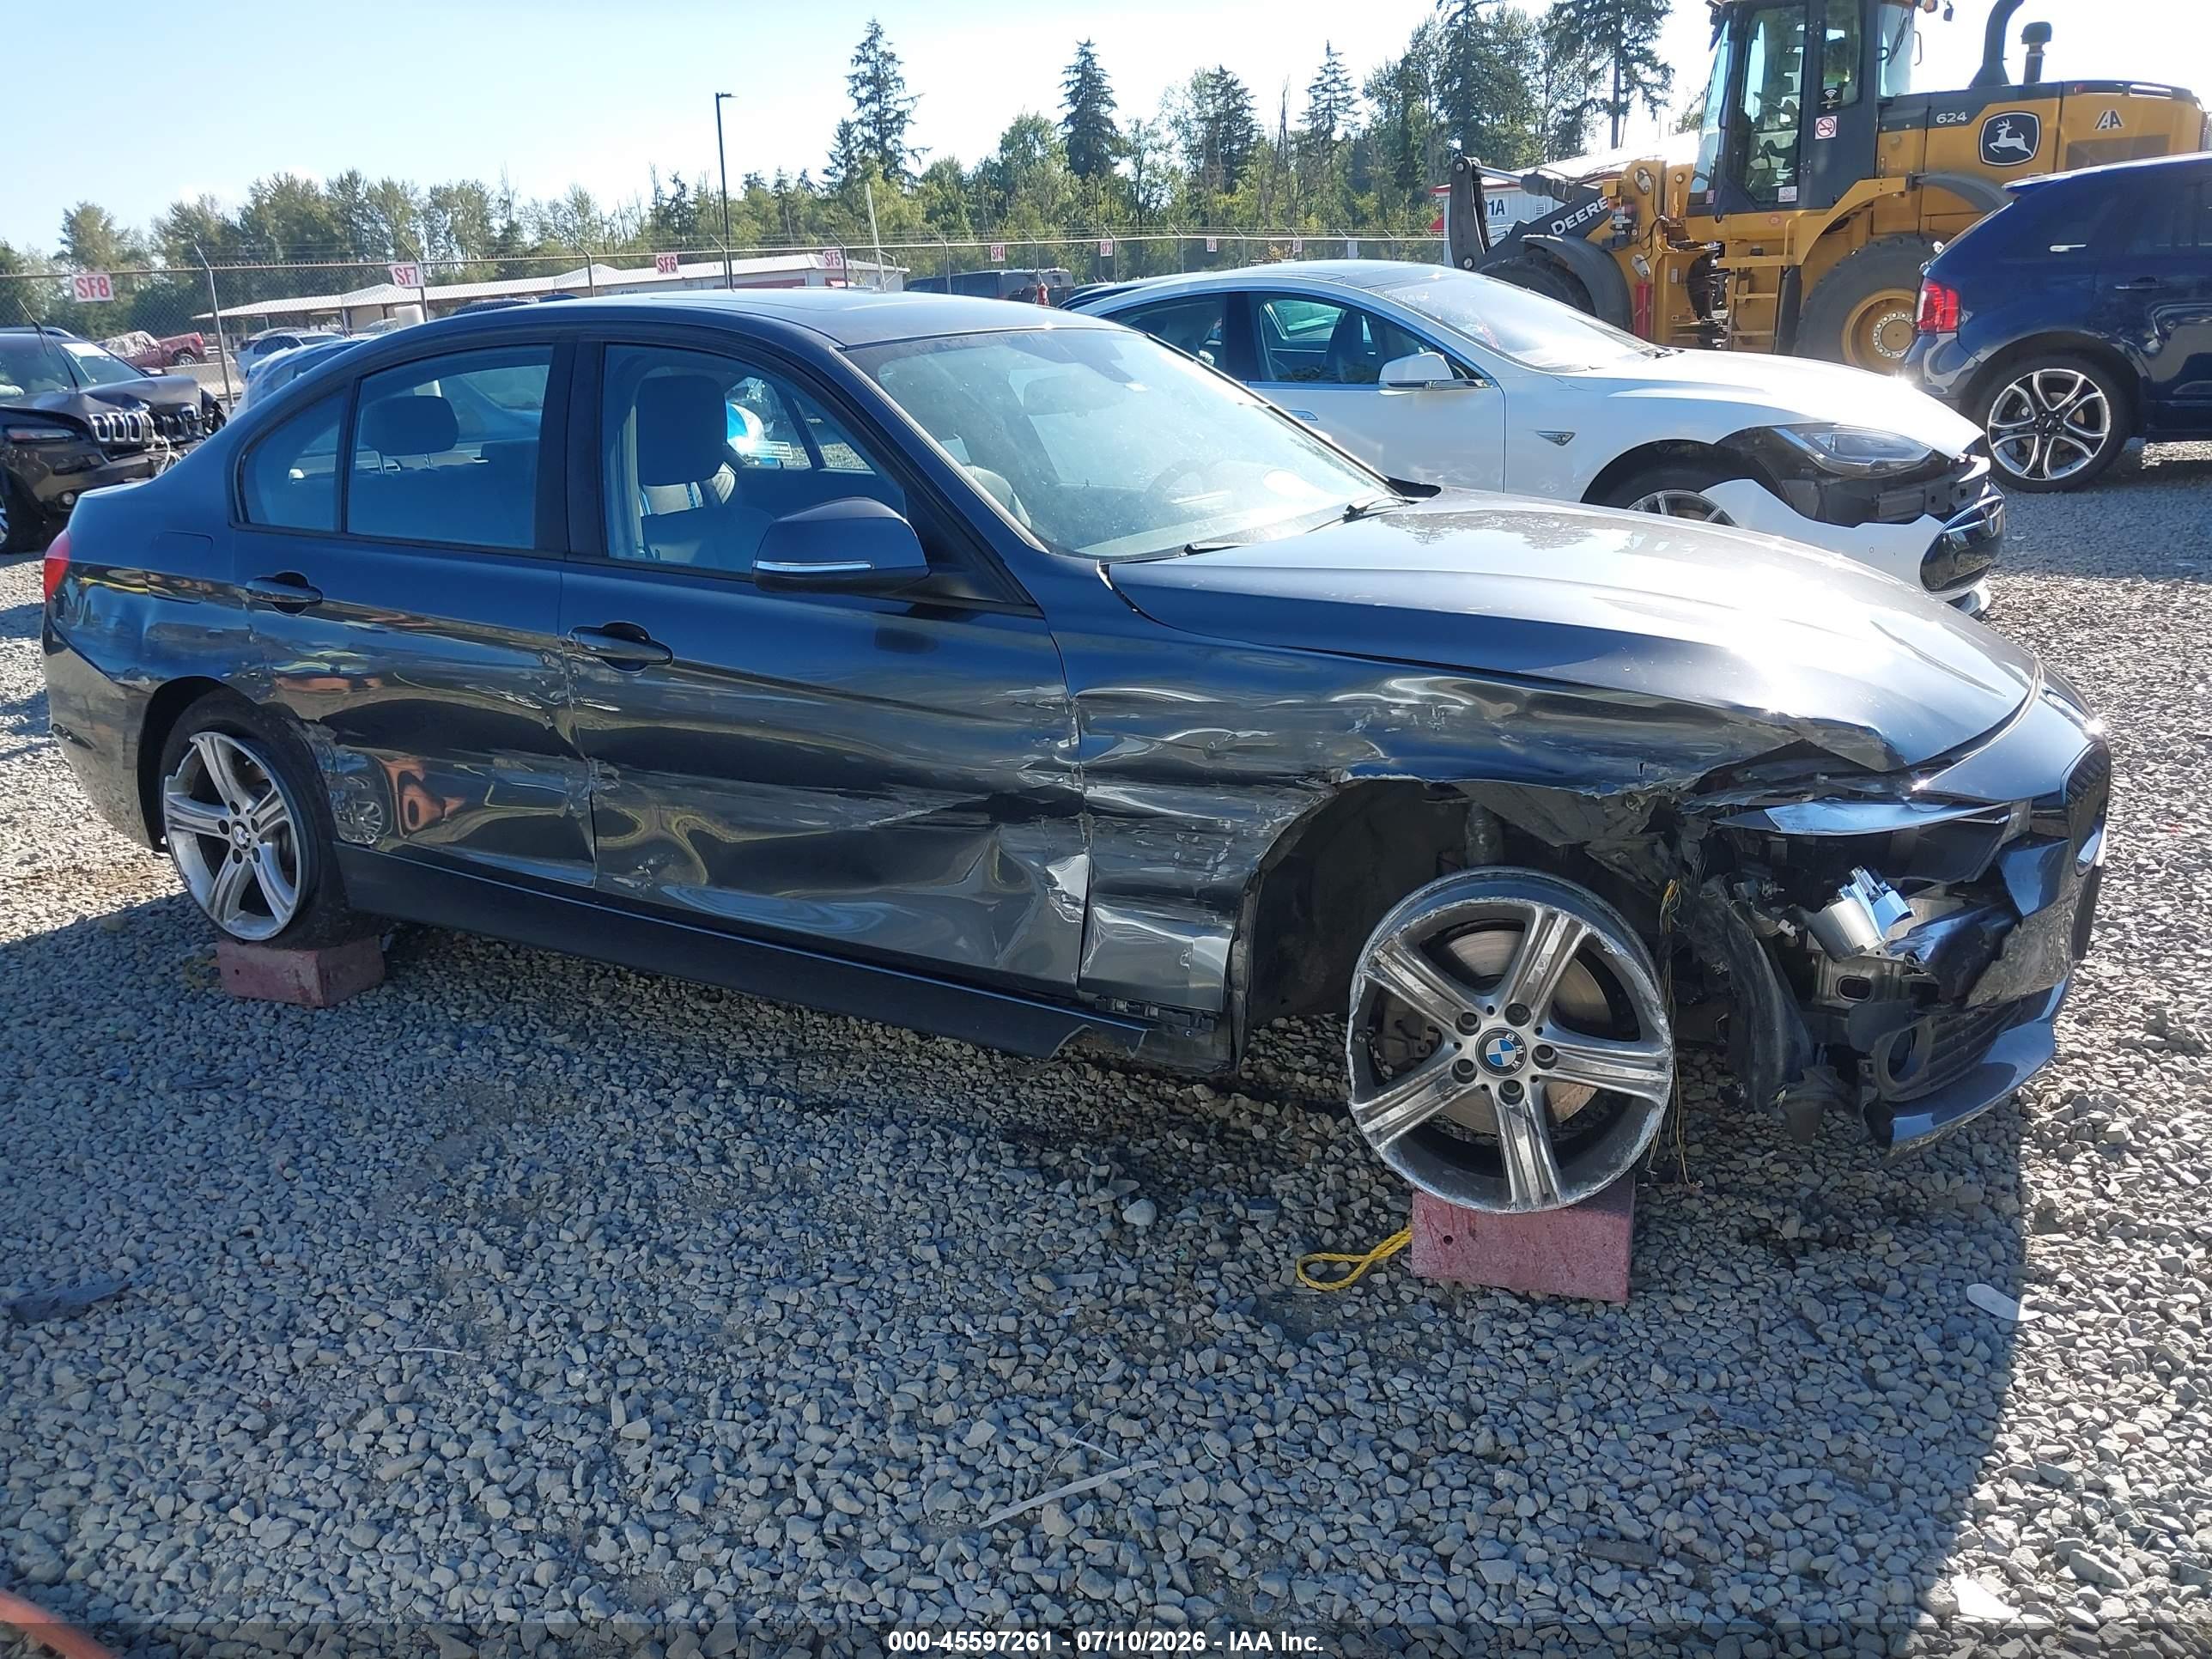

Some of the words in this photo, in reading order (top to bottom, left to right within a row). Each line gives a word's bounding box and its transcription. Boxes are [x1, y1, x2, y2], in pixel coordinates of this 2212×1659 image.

[1936, 112, 1967, 124] 624
[1551, 196, 1608, 235] DEERE
[992, 246, 1004, 260] SF4
[1101, 242, 1112, 255] SF3
[658, 256, 677, 273] SF6
[824, 252, 841, 267] SF5
[395, 267, 418, 285] SF7
[76, 276, 110, 298] SF8
[1505, 1033, 1524, 1070] BMW
